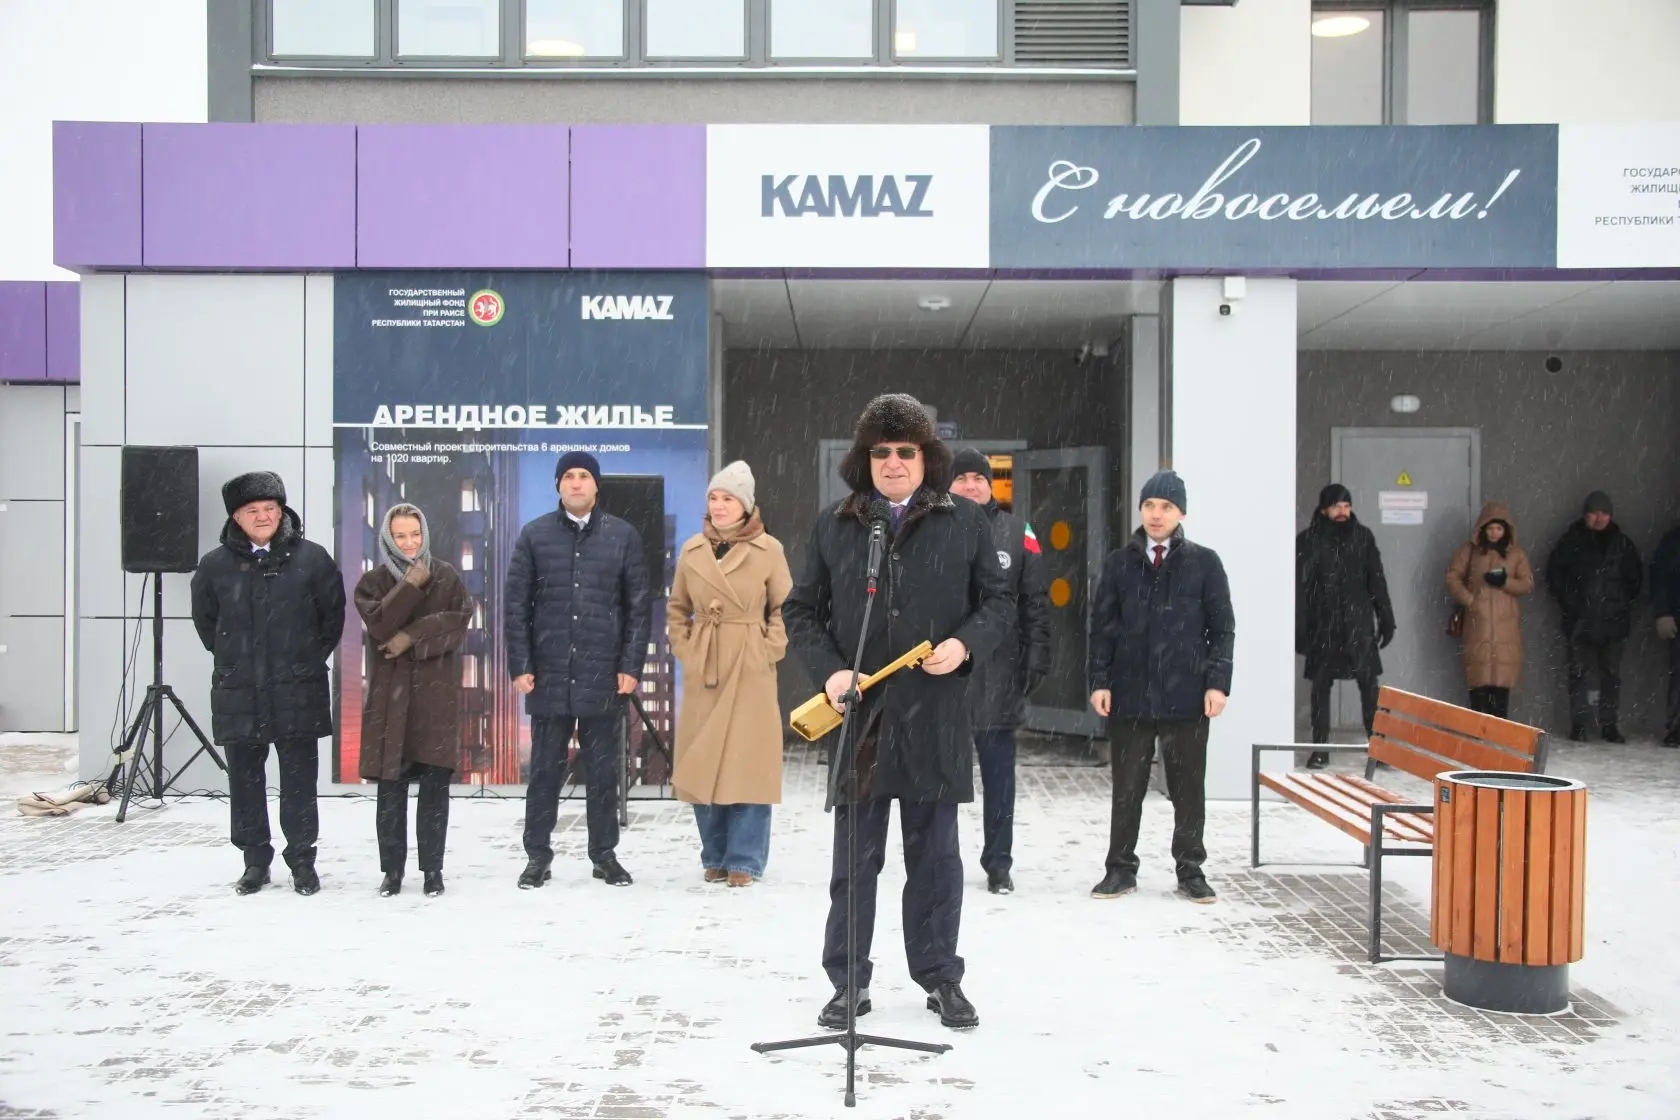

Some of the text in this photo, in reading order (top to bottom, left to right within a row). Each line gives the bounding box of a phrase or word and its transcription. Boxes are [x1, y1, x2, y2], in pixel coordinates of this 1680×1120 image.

[1623, 167, 1680, 178] ГОСУДАР
[1031, 160, 1099, 223] С
[1631, 183, 1680, 194] ЖИЛИЩ
[761, 174, 934, 217] KAMAZ
[1595, 215, 1674, 226] РЕСПУБЛИКИ
[389, 288, 465, 297] ГОСУДАРСТВЕННЫЙ
[393, 298, 465, 308] ЖИЛИЩНЫЙ ФОНД
[581, 295, 674, 320] KAMAZ
[423, 309, 465, 317] ПРИ РАИСЕ
[371, 319, 465, 327] РЕСПУБЛИКИ ТАТАРСТАН
[372, 404, 674, 431] АРЕНДНОЕ ЖИЛЬЕ
[371, 441, 630, 454] Совместный проект строительства 6 арендных домов
[371, 453, 452, 465] на 1020 квартир.
